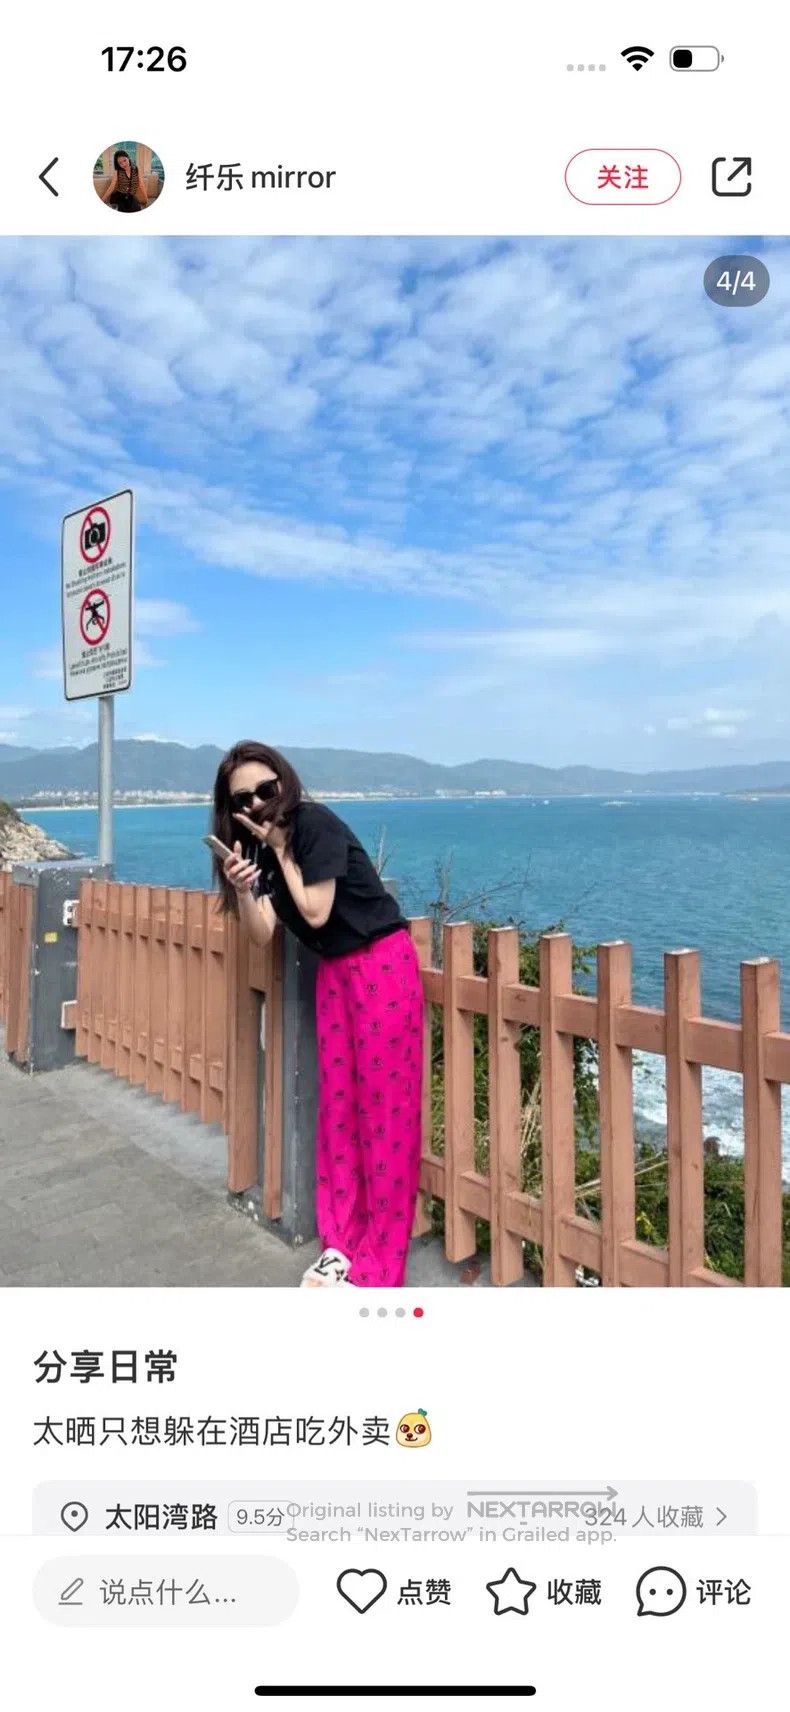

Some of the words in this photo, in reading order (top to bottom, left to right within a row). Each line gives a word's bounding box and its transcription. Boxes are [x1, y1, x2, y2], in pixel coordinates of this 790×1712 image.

[102, 46, 187, 72] 17:26
[185, 162, 244, 191] 纤乐
[252, 164, 336, 188] mirror
[597, 165, 649, 189] 关注
[716, 270, 756, 295] 4/4
[33, 1349, 178, 1384] 分享日常
[33, 1415, 391, 1447] 太晒只想躲在酒店吃外卖
[105, 1503, 218, 1531] 太阳湾路
[236, 1507, 285, 1527] 9.5分
[396, 1578, 452, 1606] 点赞
[547, 1578, 602, 1606] 收藏
[695, 1578, 752, 1606] 评论
